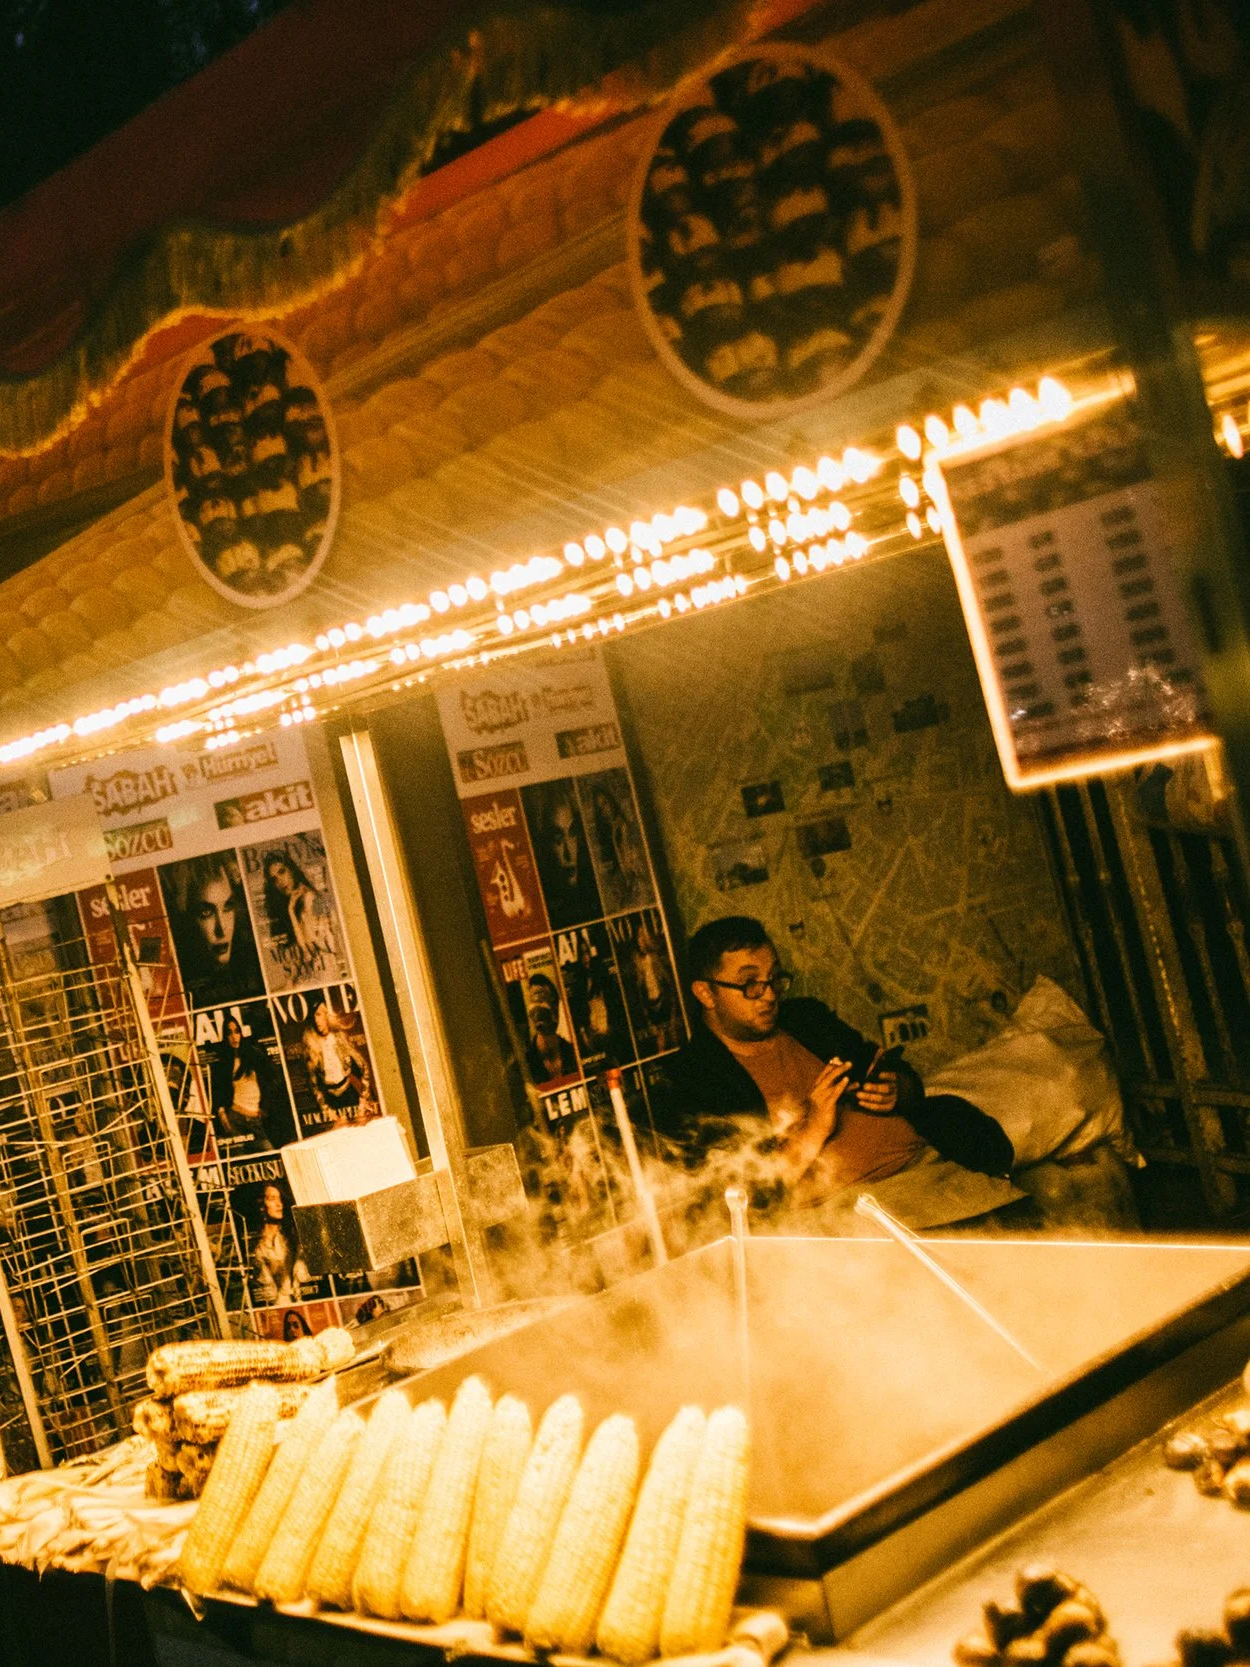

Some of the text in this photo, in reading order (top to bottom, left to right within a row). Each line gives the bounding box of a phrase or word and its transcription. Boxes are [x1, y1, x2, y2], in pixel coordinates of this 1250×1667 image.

[91, 769, 176, 811] SABAH
[245, 785, 314, 820] akit
[471, 801, 517, 834] sesler
[90, 882, 152, 919] seler
